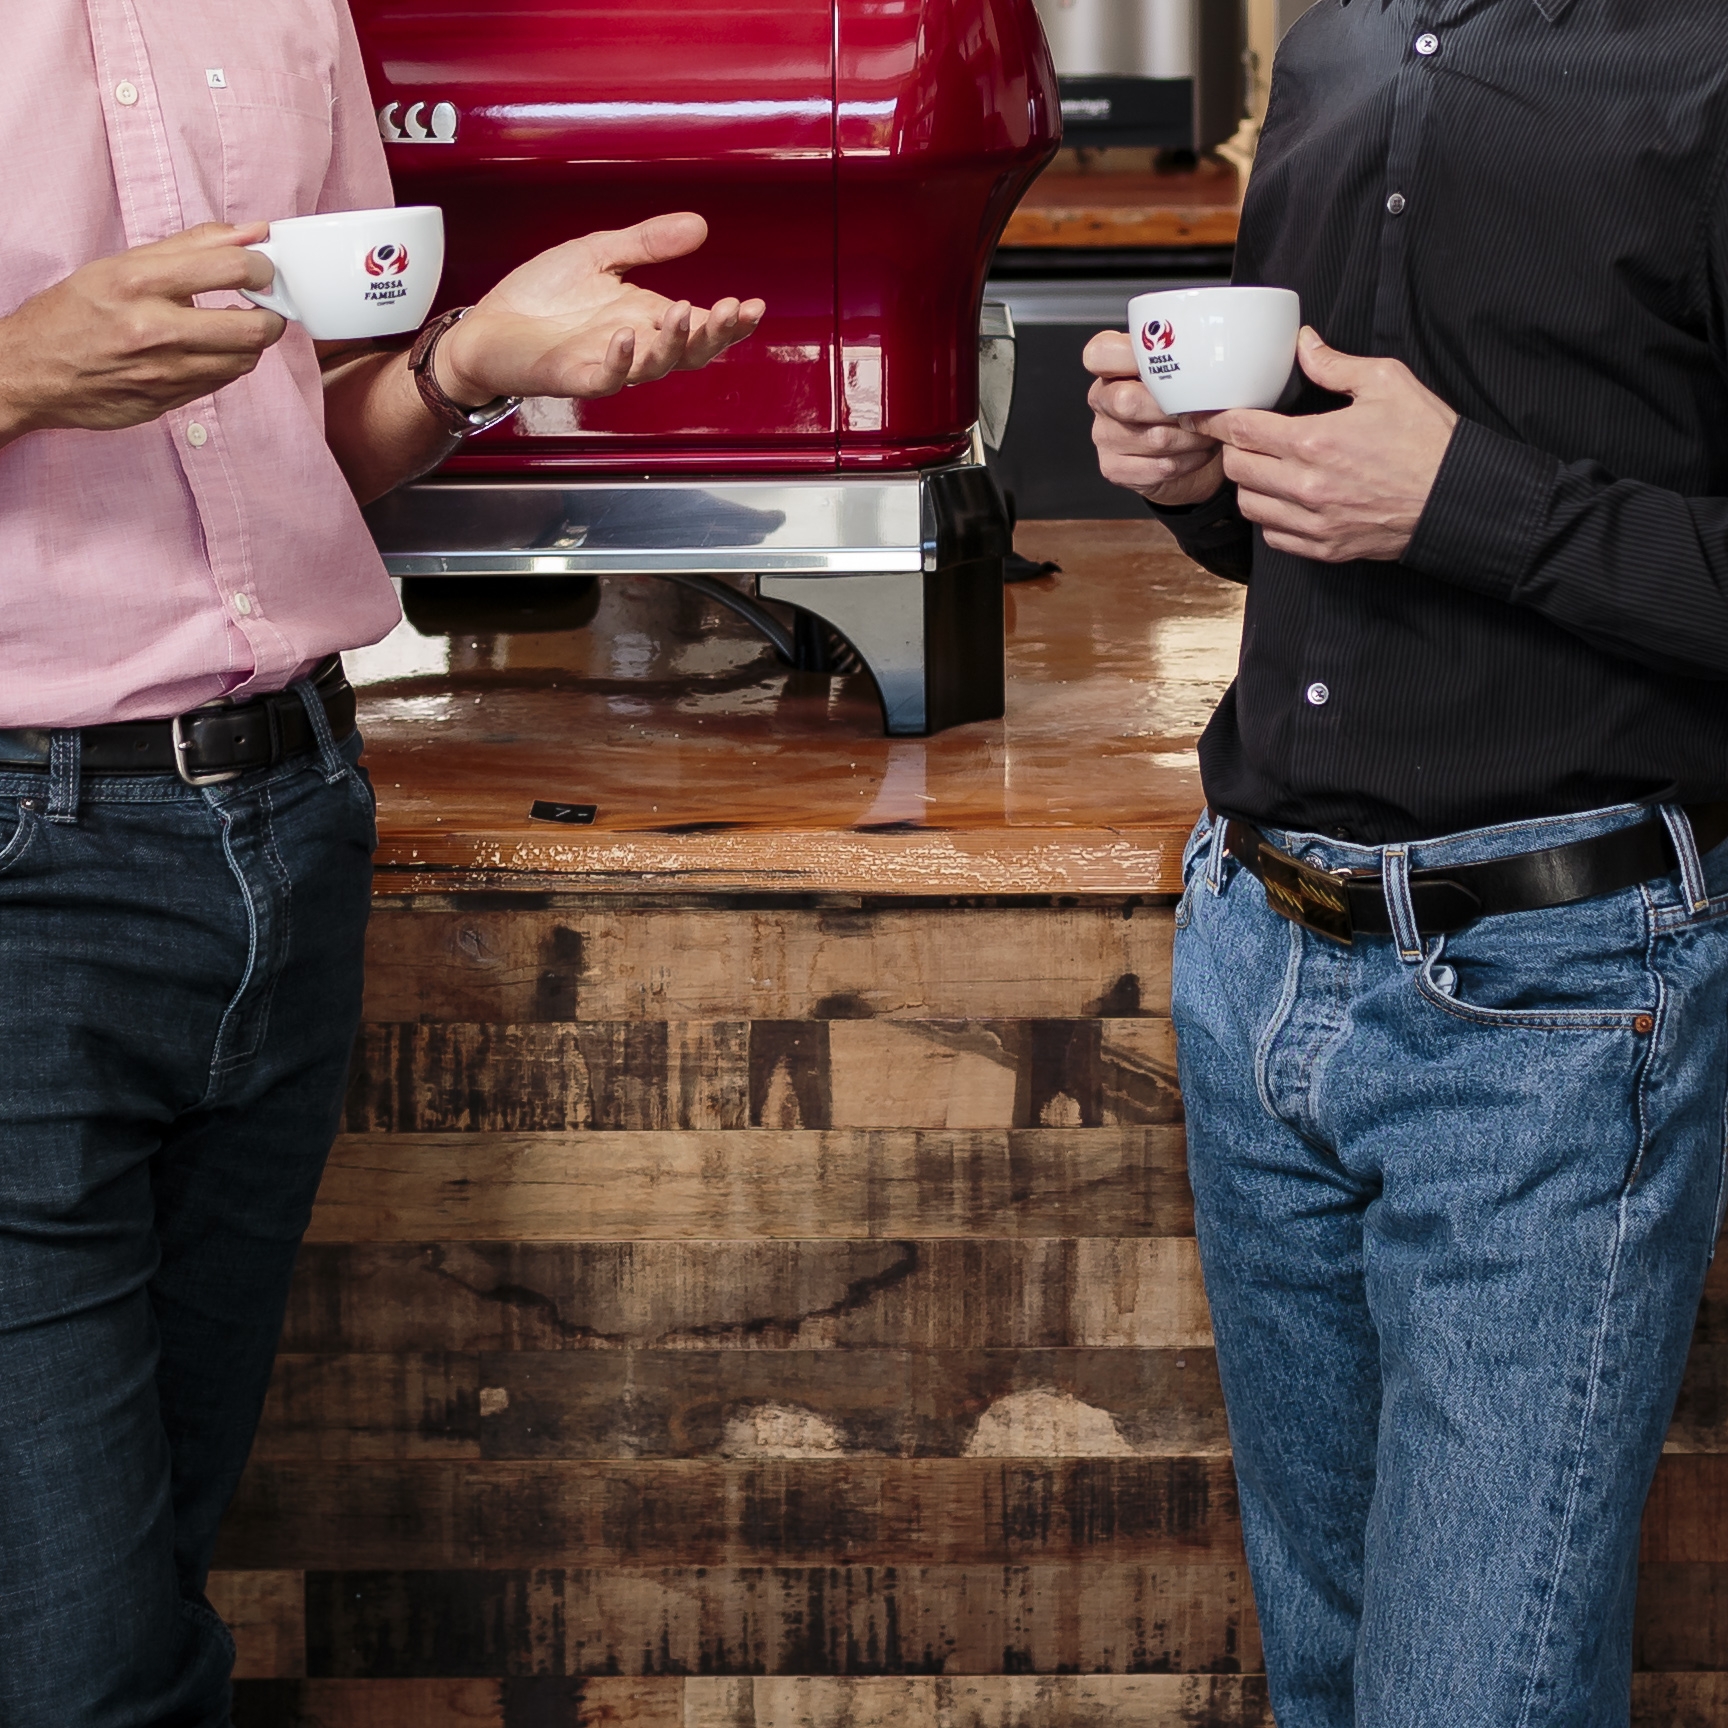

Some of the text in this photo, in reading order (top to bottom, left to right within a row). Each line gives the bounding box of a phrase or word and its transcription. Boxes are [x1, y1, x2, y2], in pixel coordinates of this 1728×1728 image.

[369, 279, 404, 291] NOSSA
[364, 288, 408, 301] FAMILIA
[1148, 354, 1173, 365] NOSSA
